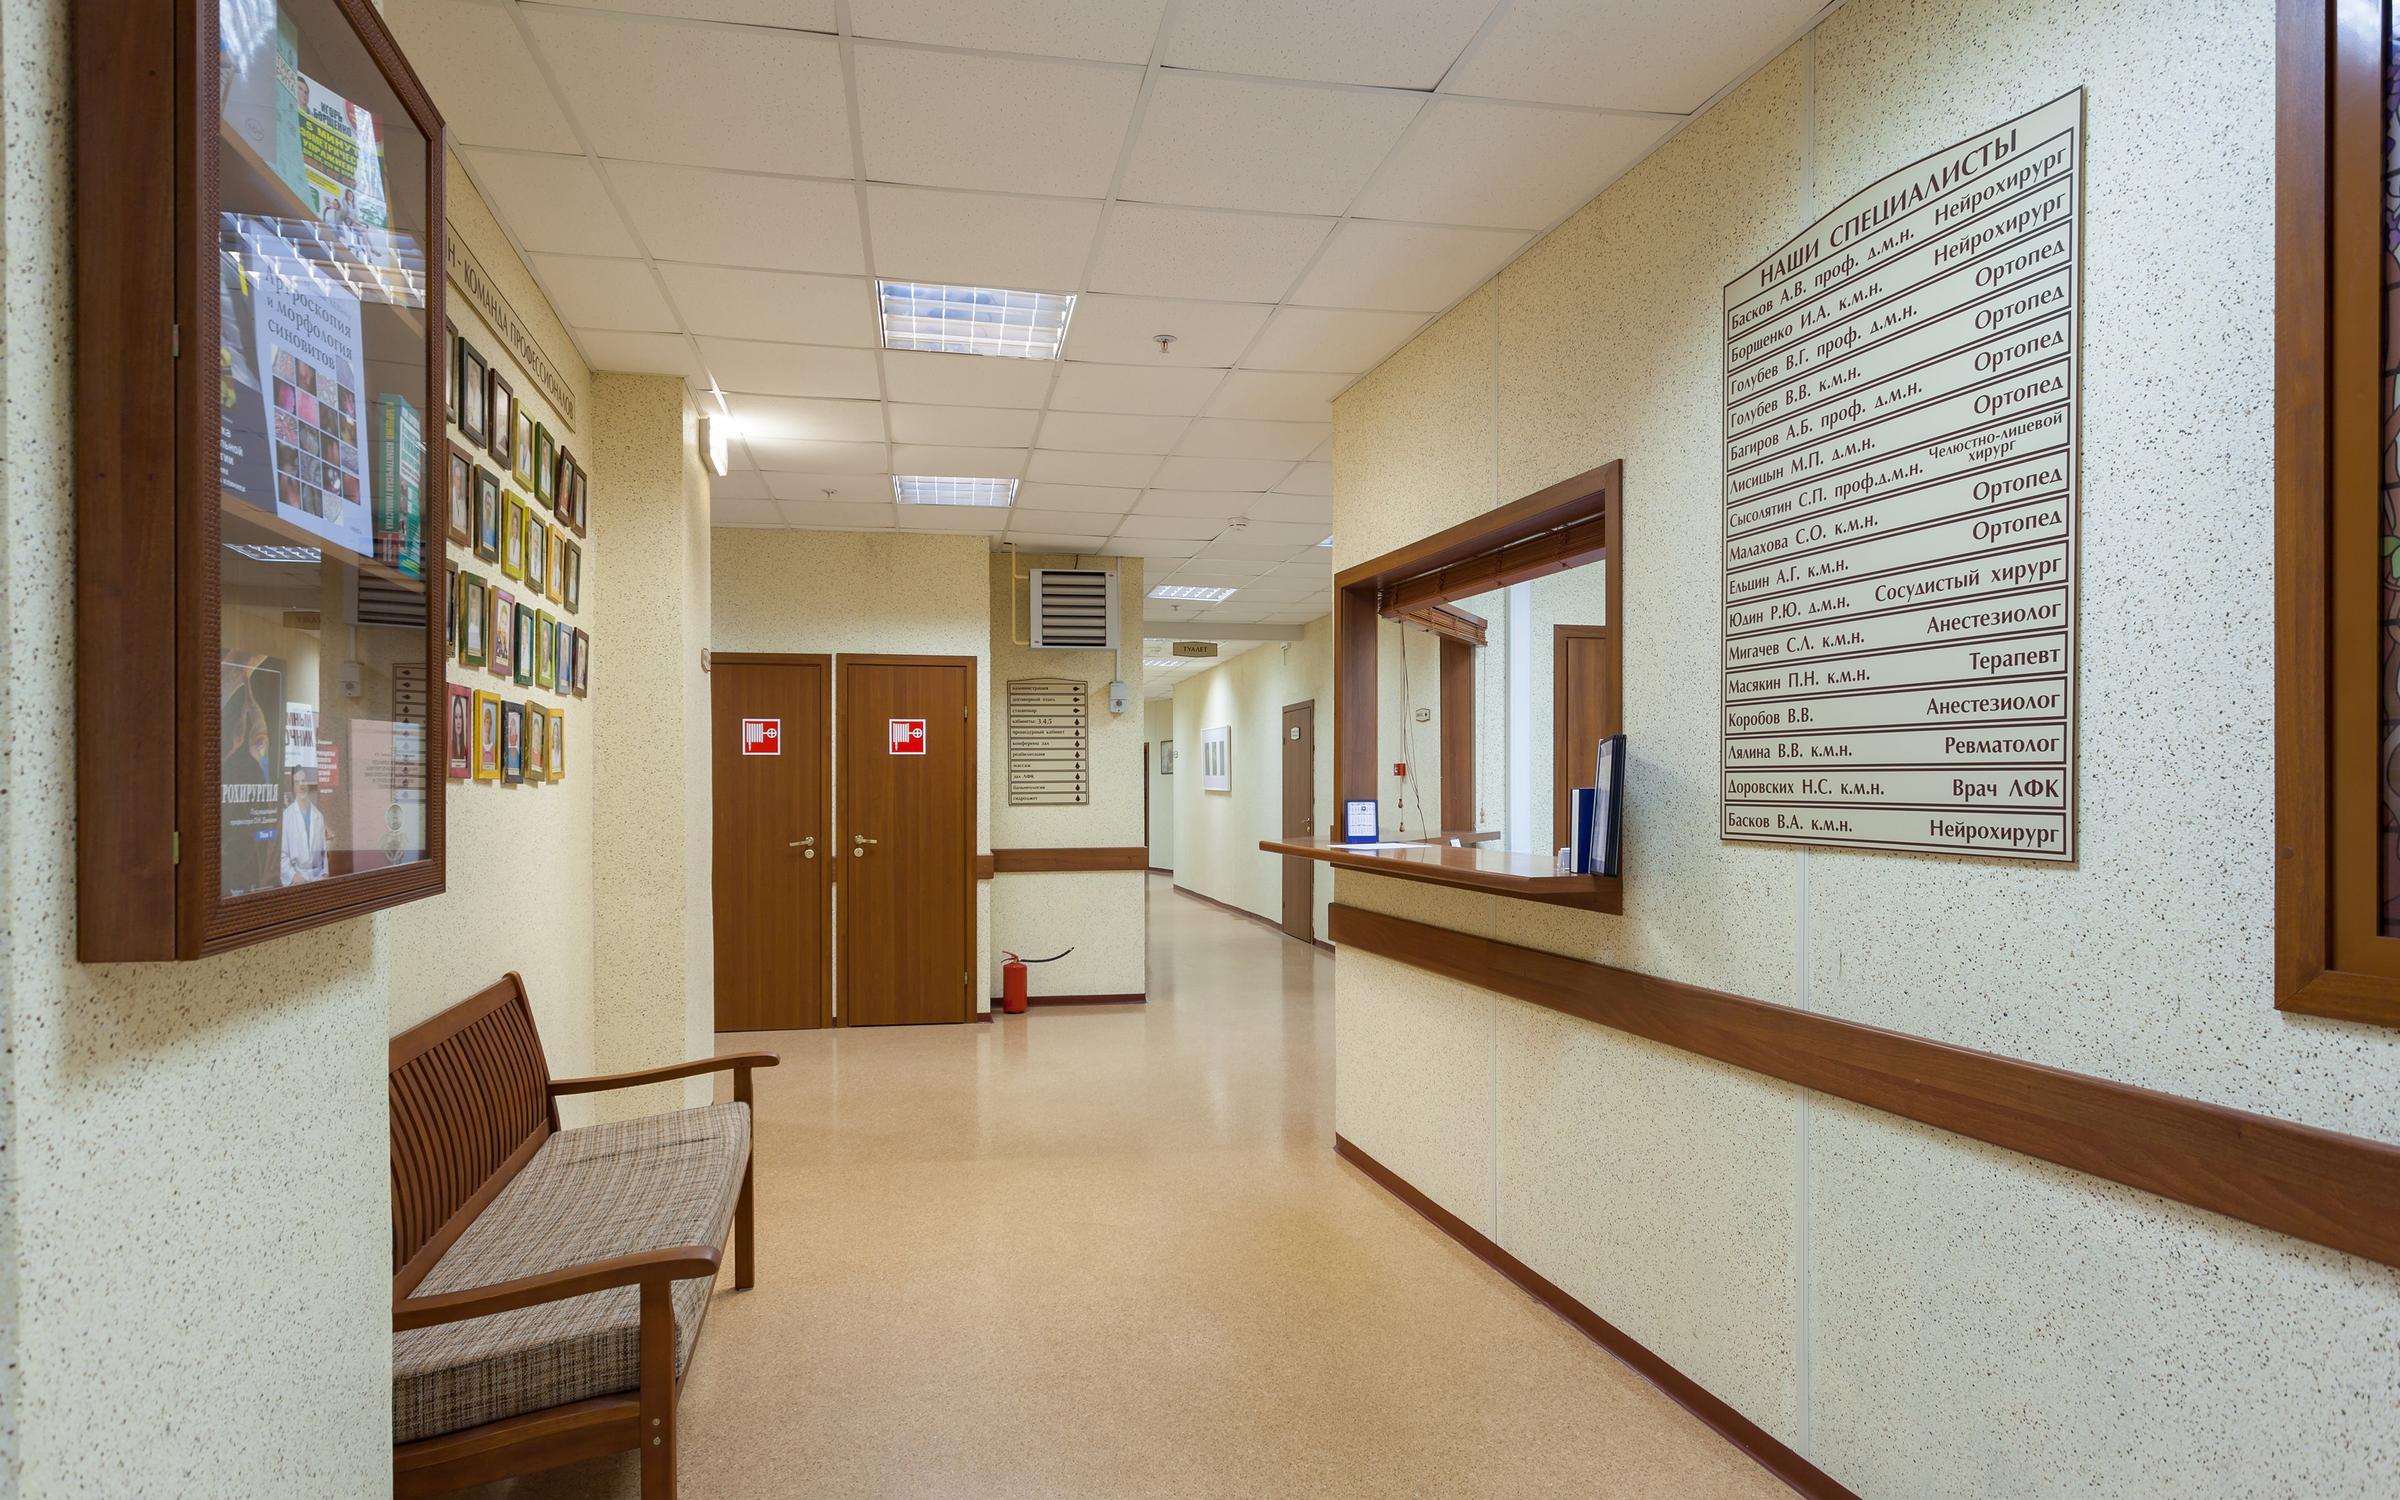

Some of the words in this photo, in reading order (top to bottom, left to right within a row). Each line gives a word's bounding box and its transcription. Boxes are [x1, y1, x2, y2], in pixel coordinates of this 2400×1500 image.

[1732, 300, 1773, 330] Басков
[1780, 281, 1806, 304] А.В.
[1815, 254, 1858, 288] проф.
[1868, 229, 1914, 260] д.м.н.
[1936, 148, 2066, 225] Нейрохирург
[1761, 238, 1818, 287] НАШИ
[1830, 128, 2016, 247] СПЕЦИАЛИСТЫ
[1801, 305, 1830, 329] И.А.
[1840, 283, 1882, 310] к.м.н.
[1935, 193, 2065, 266] Нейрохирург
[265, 263, 352, 339] Артроскопия
[276, 302, 352, 361] морфология
[1732, 366, 1778, 395] Голубев
[1786, 349, 1808, 370] В.Г.
[1818, 326, 1861, 358] проф.
[1870, 305, 1917, 334] д.м.н.
[1976, 240, 2064, 286] Ортопед
[267, 319, 336, 371] синовитов
[464, 259, 508, 337] КОМАНДА
[510, 321, 574, 421] ПРОФЕССИОНАЛОВ
[1732, 400, 1778, 428] Голубев
[1786, 384, 1810, 405] В.В.
[1820, 368, 1860, 392] к.м.н.
[1975, 286, 2064, 330] Ортопед
[1731, 434, 1778, 460] Багиров
[1786, 418, 1812, 440] А.Б.
[1822, 399, 1865, 430] проф.
[1874, 382, 1922, 408] д.м.н.
[1975, 331, 2064, 372] Ортопед
[1730, 467, 1783, 494] Лисицын
[1791, 451, 1823, 474] М.П.
[1832, 438, 1875, 461] д.м.н.
[1974, 376, 2063, 415] Ортопед
[1730, 501, 1791, 527] Сысолятин
[1799, 488, 1826, 507] С.П.
[1929, 411, 2062, 459] Челюстно-лицевой
[1968, 440, 2016, 462] хирург
[1730, 538, 1788, 562] Малахова
[1796, 525, 1826, 544] С.О.
[1836, 515, 1878, 535] к.м.н.
[1973, 469, 2062, 503] Ортопед
[1730, 576, 1769, 594] Ельцин
[1777, 566, 1800, 584] А.Г.
[1808, 560, 1848, 577] к.м.н.
[1973, 511, 2062, 543] Ортопед
[1730, 612, 1763, 628] Юдин
[1771, 602, 1800, 620] Р.Ю.
[1808, 597, 1850, 614] д.м.н.
[1875, 569, 1979, 602] Сосудистый
[1992, 558, 2061, 584] хирург
[1729, 644, 1779, 660] Мигачев
[1787, 636, 1814, 652] С.Л.
[1823, 632, 1864, 648] к.м.н.
[1927, 604, 2061, 634] Анестезиолог
[1729, 679, 1780, 694] Масякин
[1789, 671, 1818, 688] П.Н.
[1828, 670, 1870, 684] к.м.н.
[1969, 649, 2060, 674] Терапевт
[1728, 746, 1770, 759] Лялина
[1779, 743, 1802, 758] В.В.
[1812, 745, 1852, 757] к.м.н.
[1946, 737, 2060, 754] Ревматолог
[1729, 711, 1780, 730] Коробов
[1788, 708, 1813, 723] В.В.
[1927, 694, 2060, 715] Анестезиолог
[221, 784, 279, 803] РОХИРУРГИЯ
[1728, 780, 1794, 798] Доровских
[1803, 779, 1832, 794] Н.С.
[1841, 784, 1884, 795] к.м.н.
[1954, 779, 1996, 802] Врач
[2009, 780, 2058, 797] ЛФК
[1729, 813, 1769, 828] Басков
[1778, 814, 1803, 829] В.А.
[1812, 820, 1852, 832] к.м.н.
[1931, 820, 2059, 848] Нейрохирург
